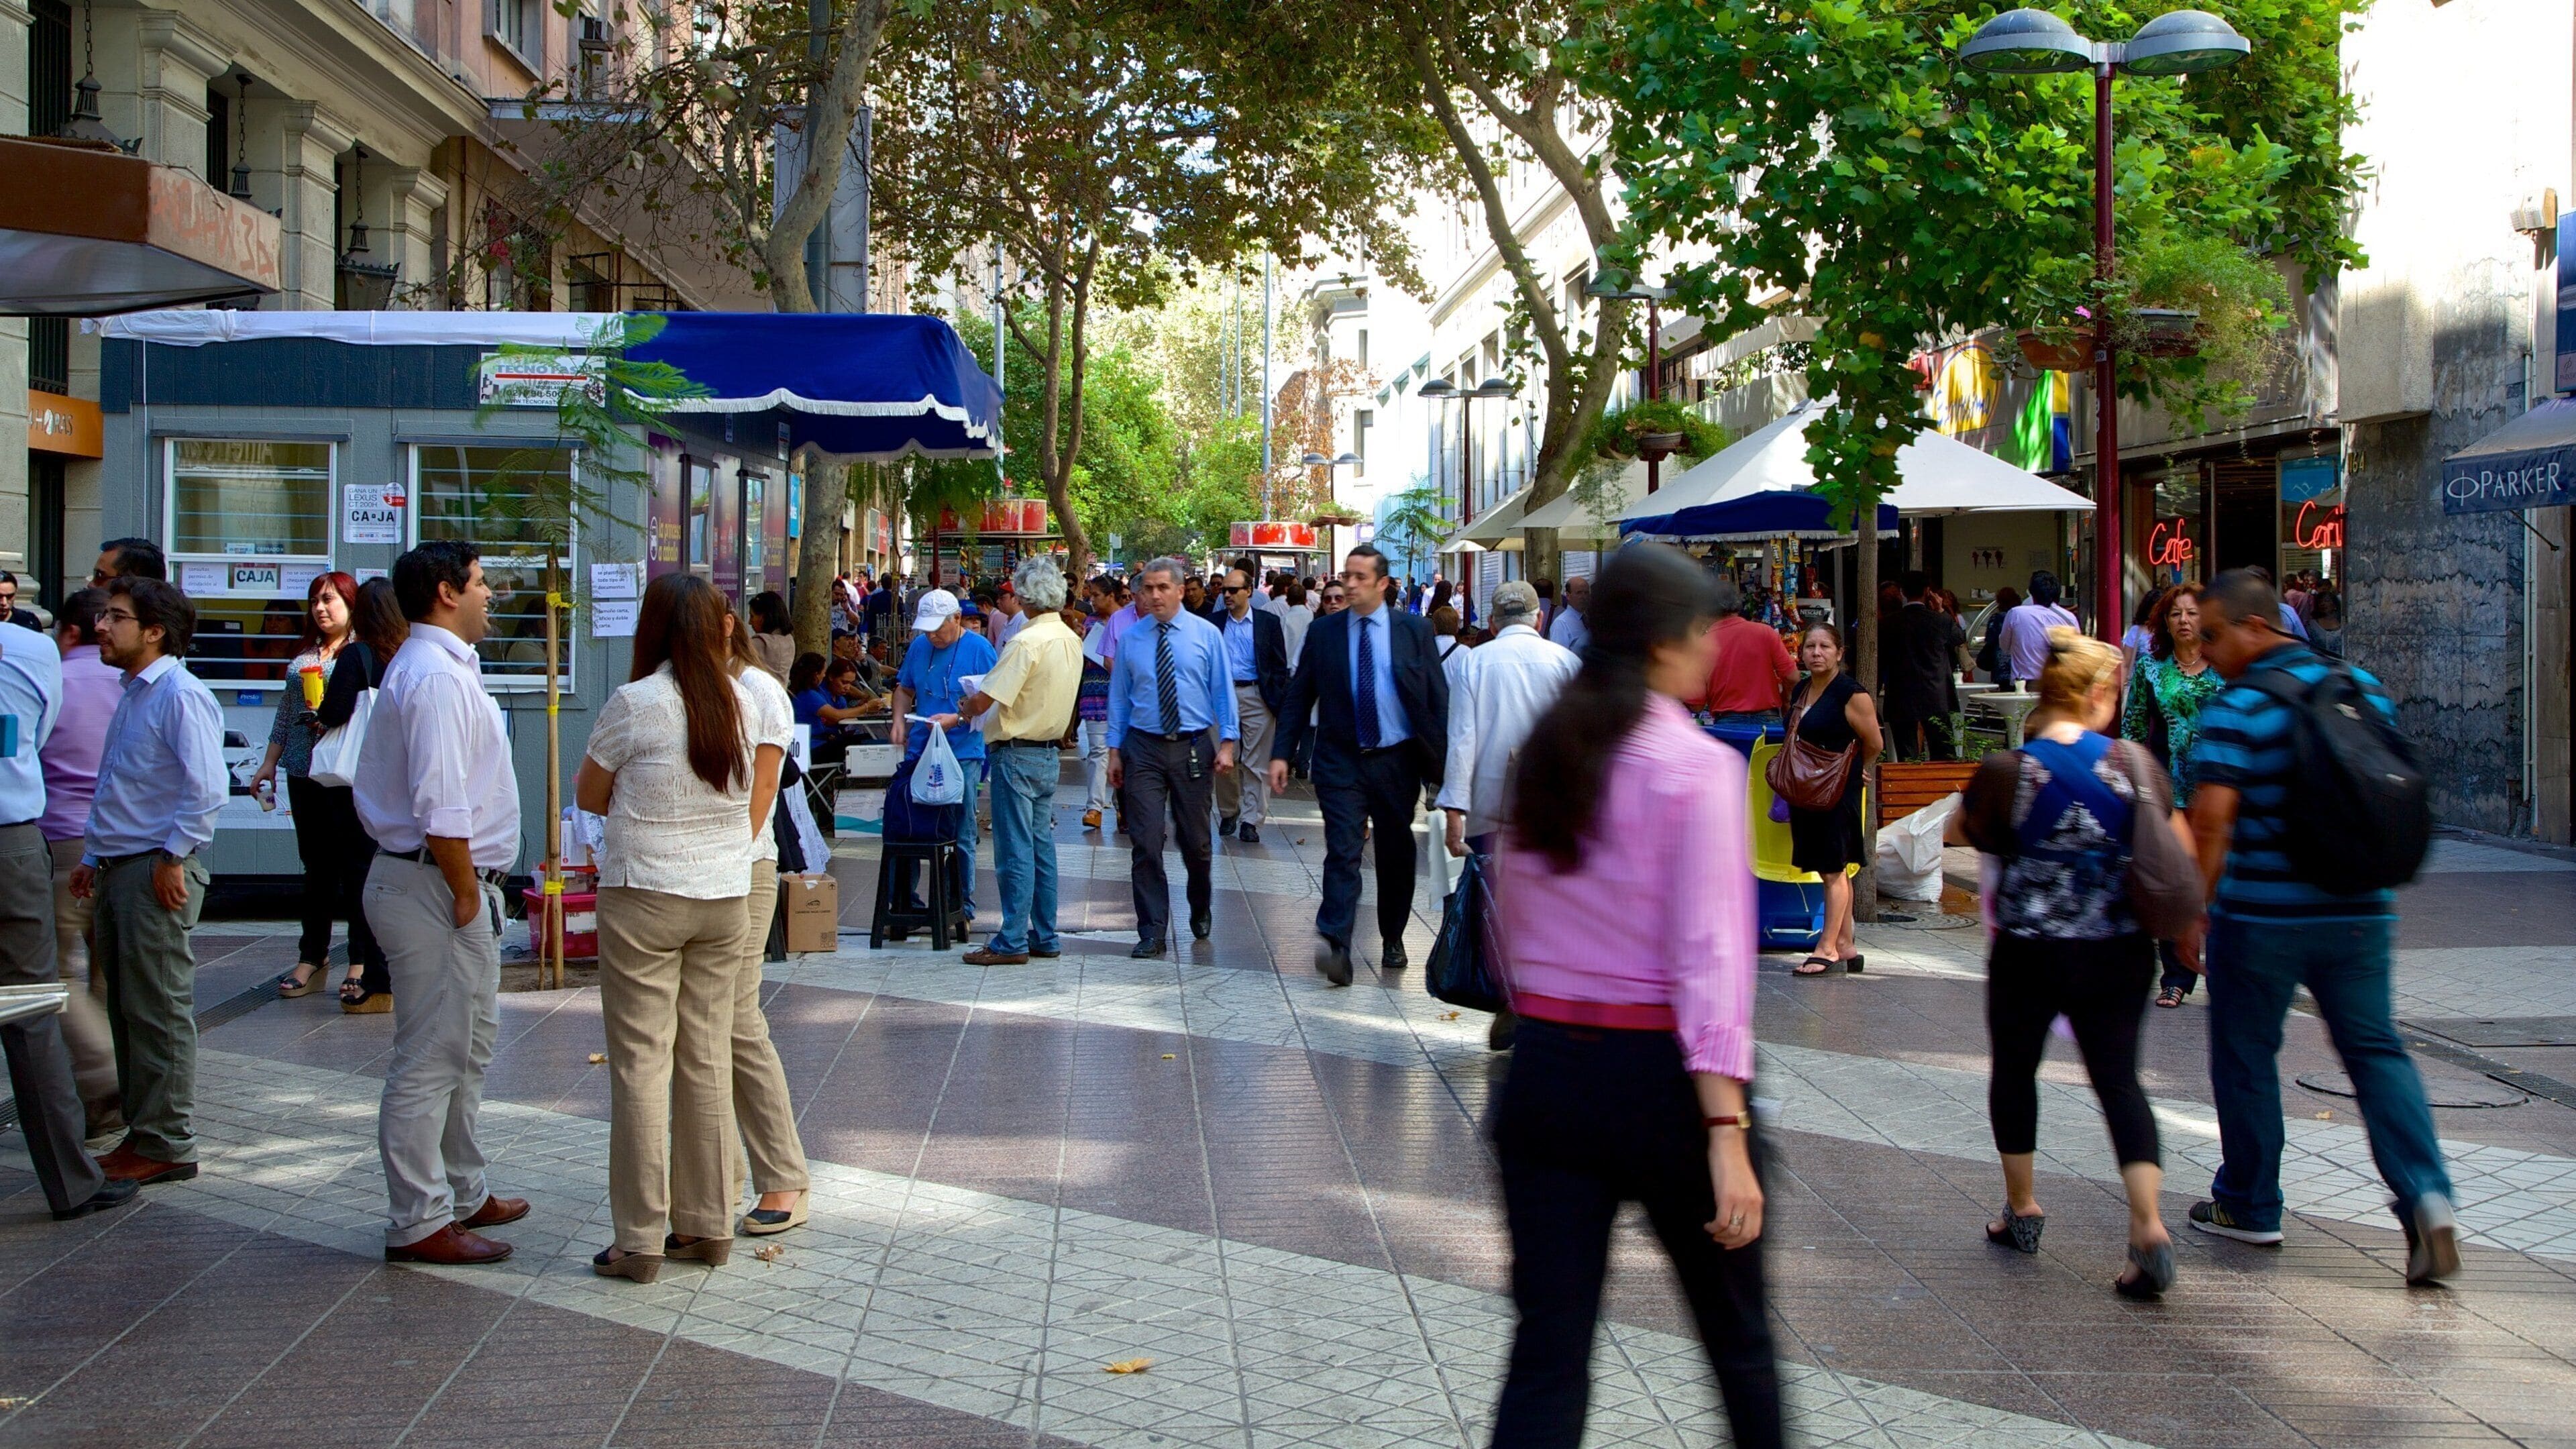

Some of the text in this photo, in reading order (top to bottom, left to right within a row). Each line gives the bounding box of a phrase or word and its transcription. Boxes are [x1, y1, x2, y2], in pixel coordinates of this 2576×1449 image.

[496, 364, 549, 374] TECNO
[36, 408, 74, 436] HORAS
[2480, 462, 2561, 499] PARKER
[236, 570, 274, 582] CAJA
